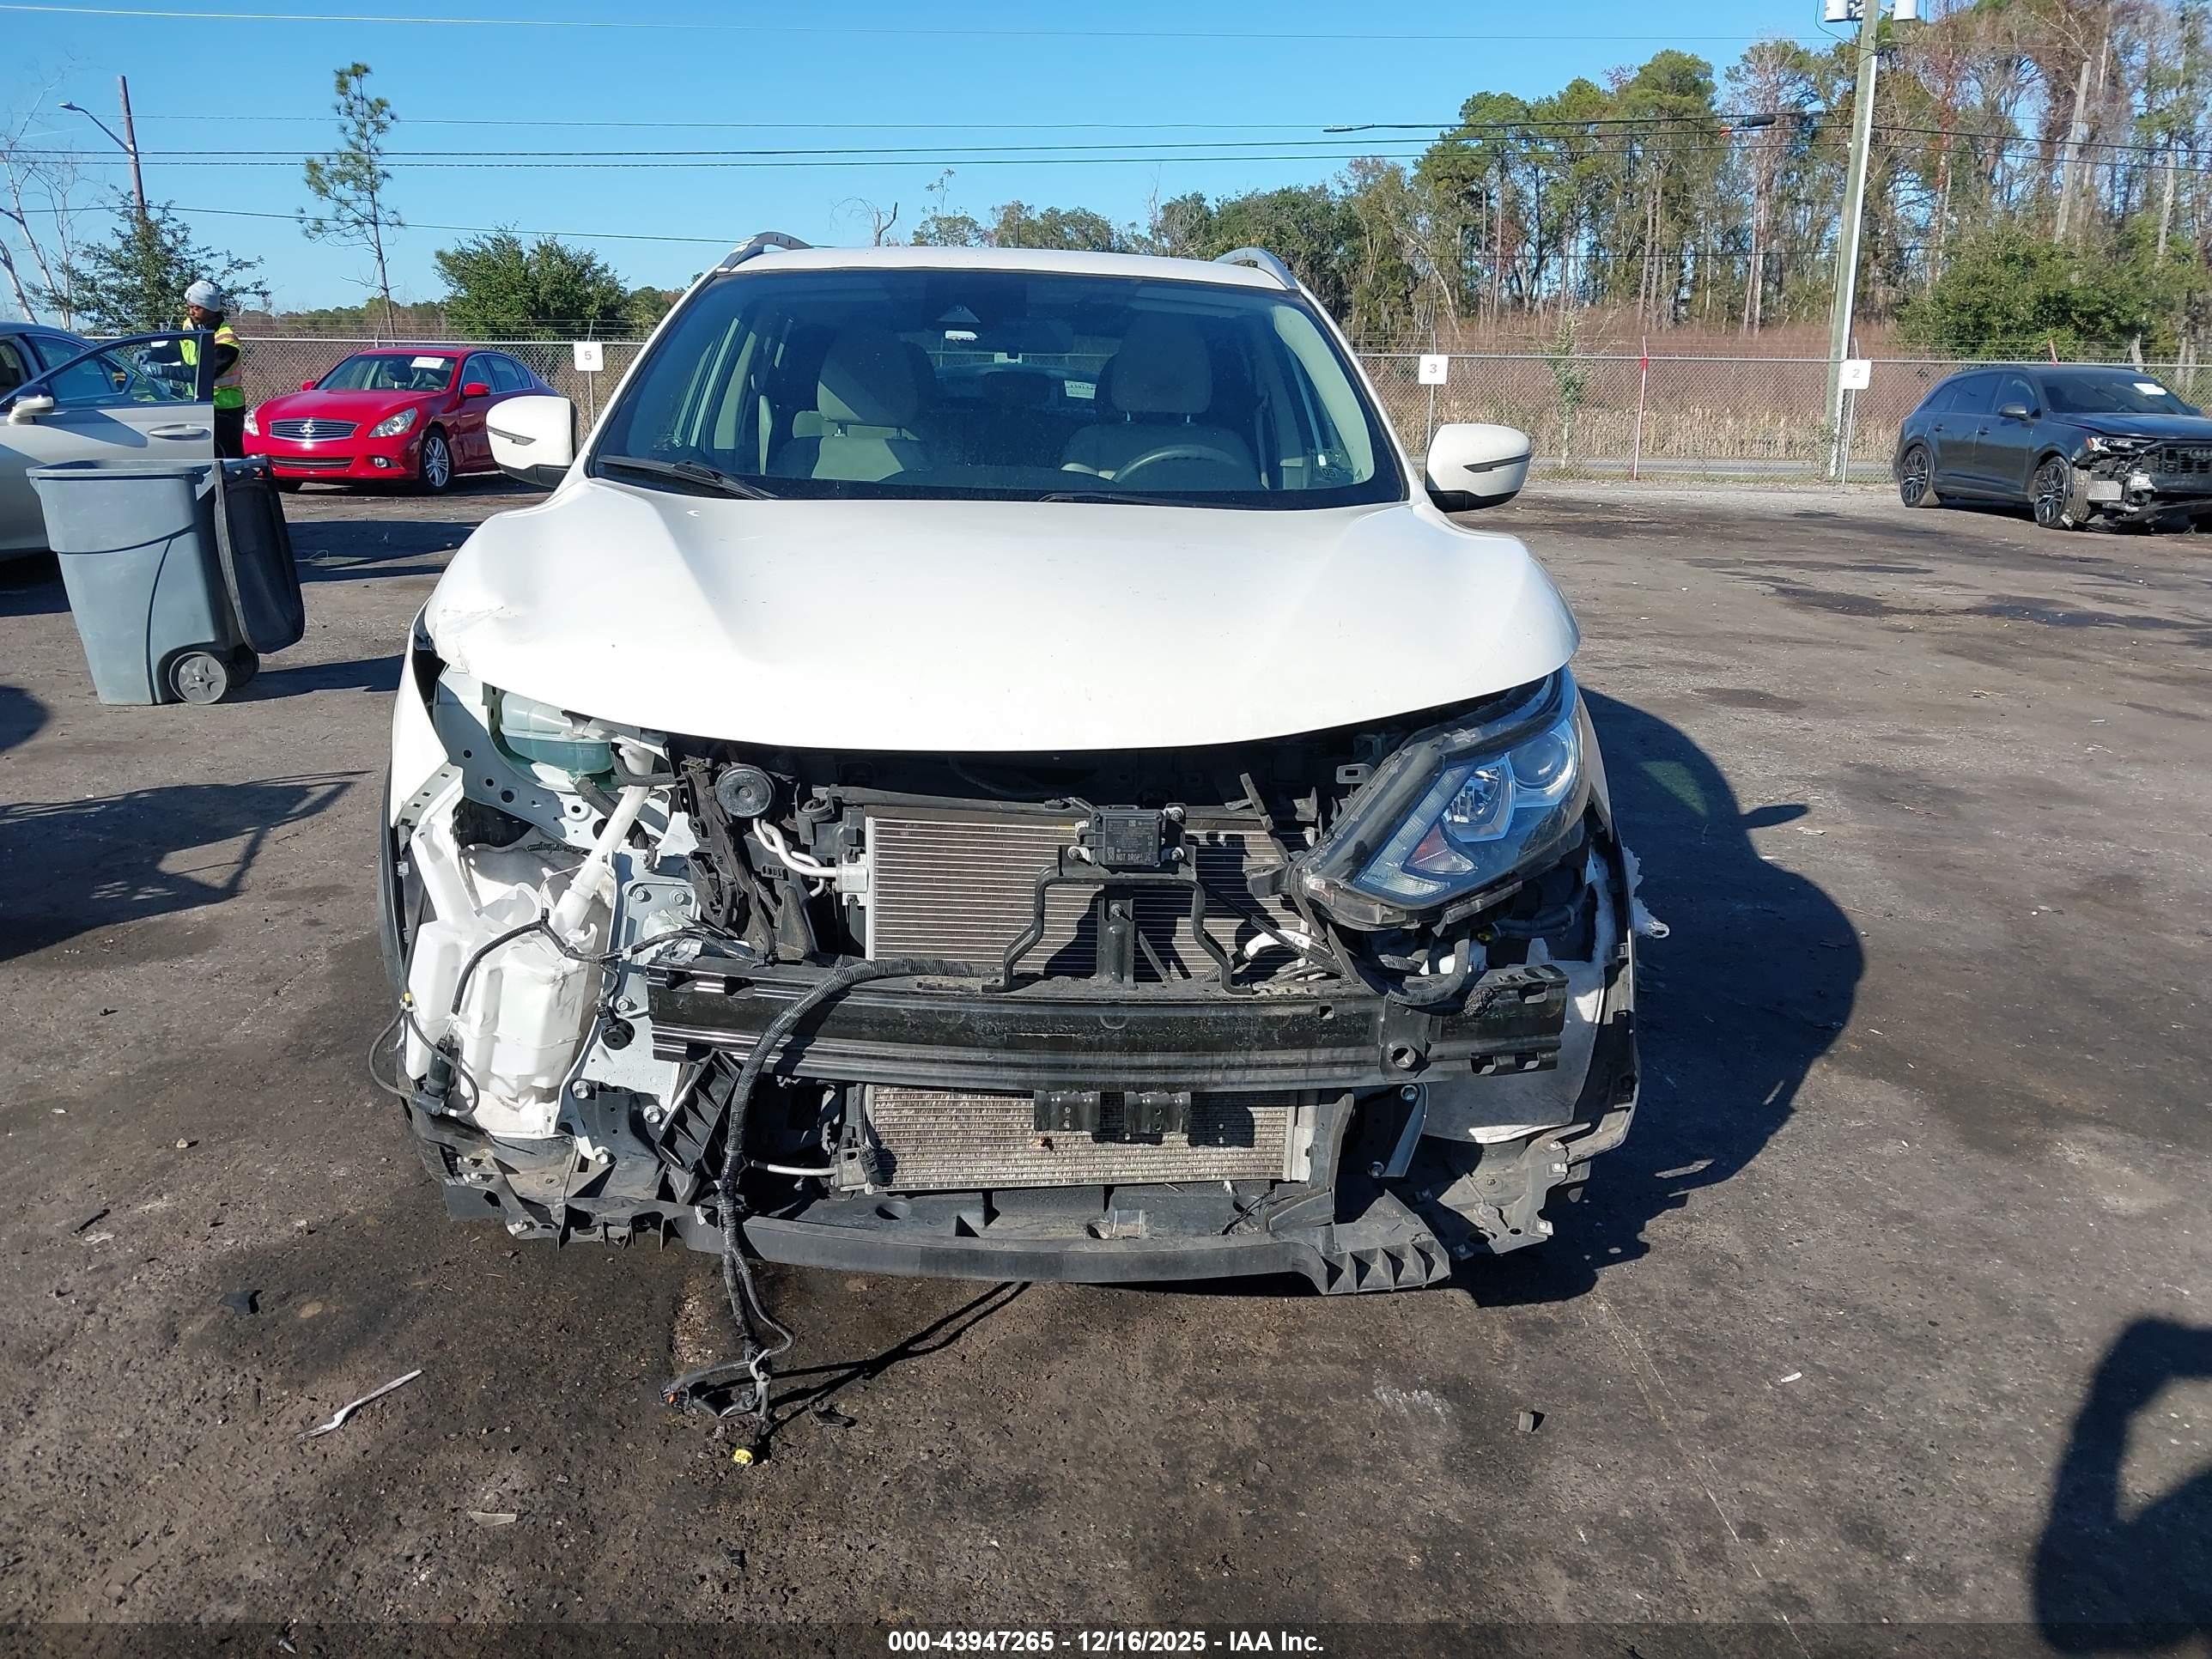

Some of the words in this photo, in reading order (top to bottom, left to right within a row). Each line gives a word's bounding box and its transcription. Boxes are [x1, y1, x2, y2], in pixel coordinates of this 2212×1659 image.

[584, 350, 592, 361] 5
[1429, 363, 1437, 374] 3
[1852, 368, 1861, 379] 2
[1116, 853, 1127, 861] NOT
